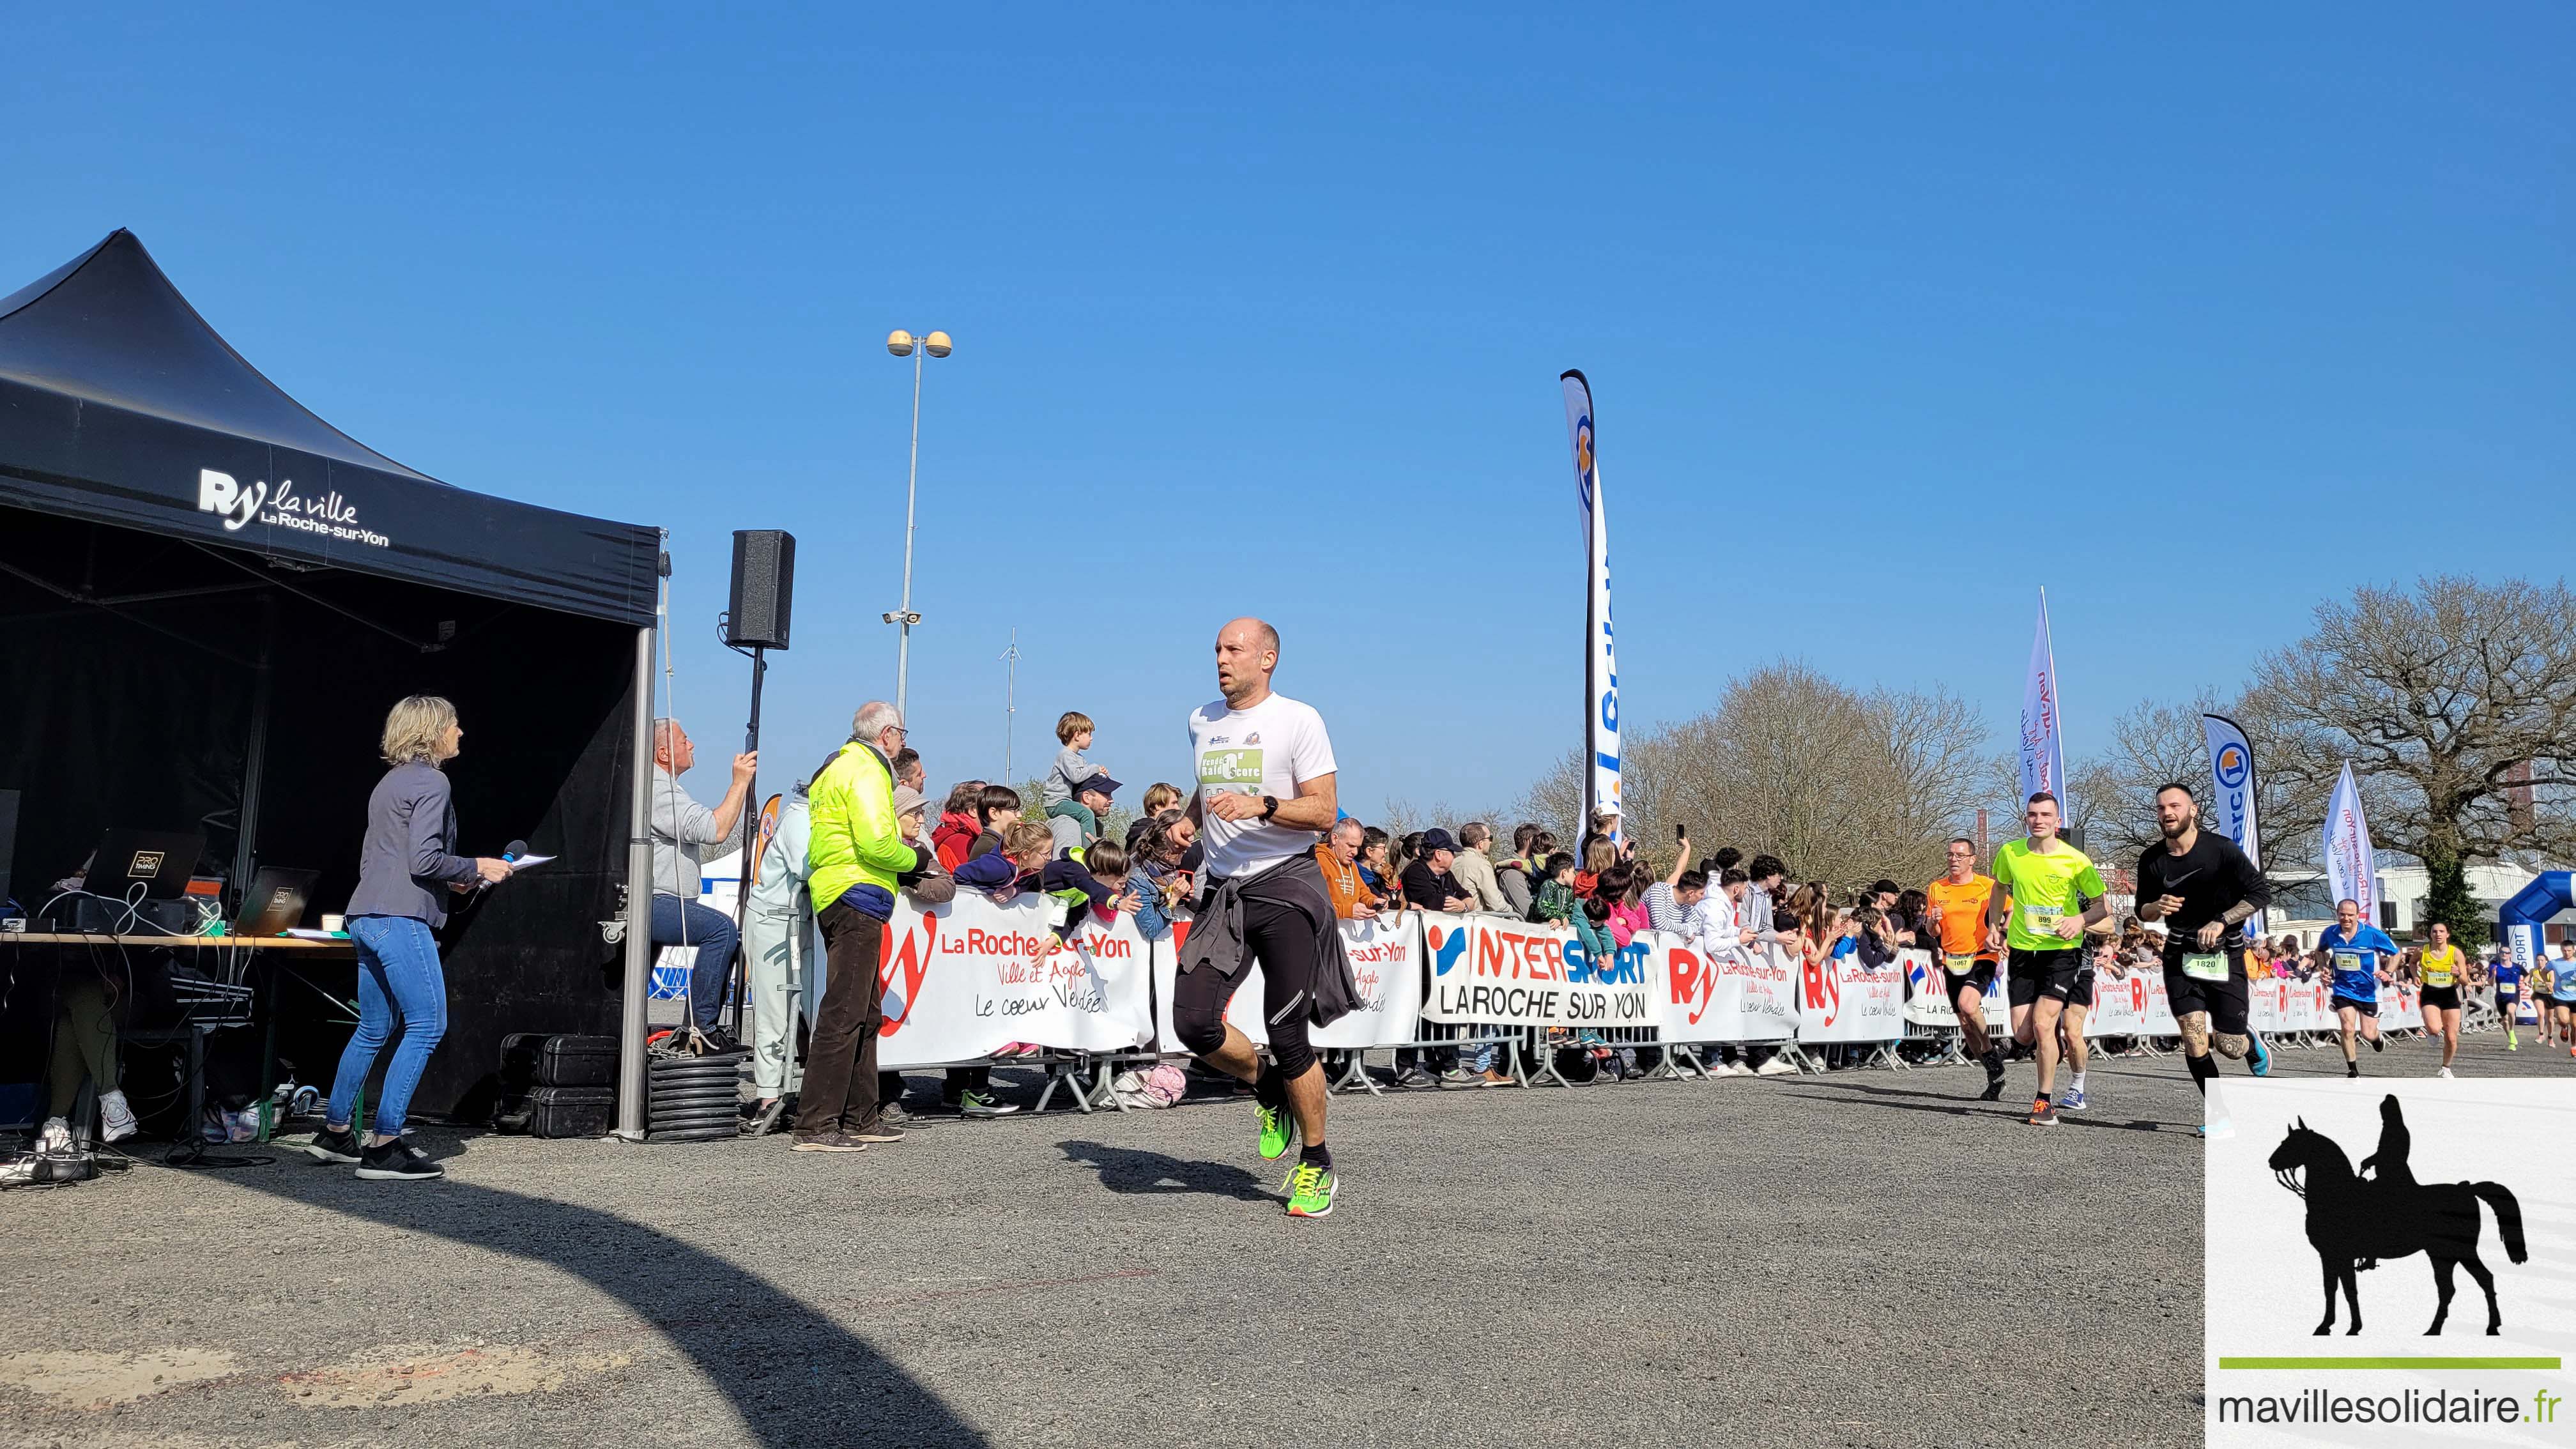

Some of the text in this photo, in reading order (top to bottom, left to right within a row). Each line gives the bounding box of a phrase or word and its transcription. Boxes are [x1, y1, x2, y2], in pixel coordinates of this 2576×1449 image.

[268, 480, 301, 512] la
[307, 491, 358, 524] ville
[137, 856, 158, 864] PRO
[942, 933, 964, 954] La
[997, 962, 1026, 985] Ville
[1029, 967, 1043, 983] et
[1354, 967, 1379, 997] Agglo
[976, 993, 994, 1016] Le
[1567, 992, 1606, 1020] SUR
[1614, 992, 1646, 1018] YON
[1927, 1005, 1938, 1015] LA
